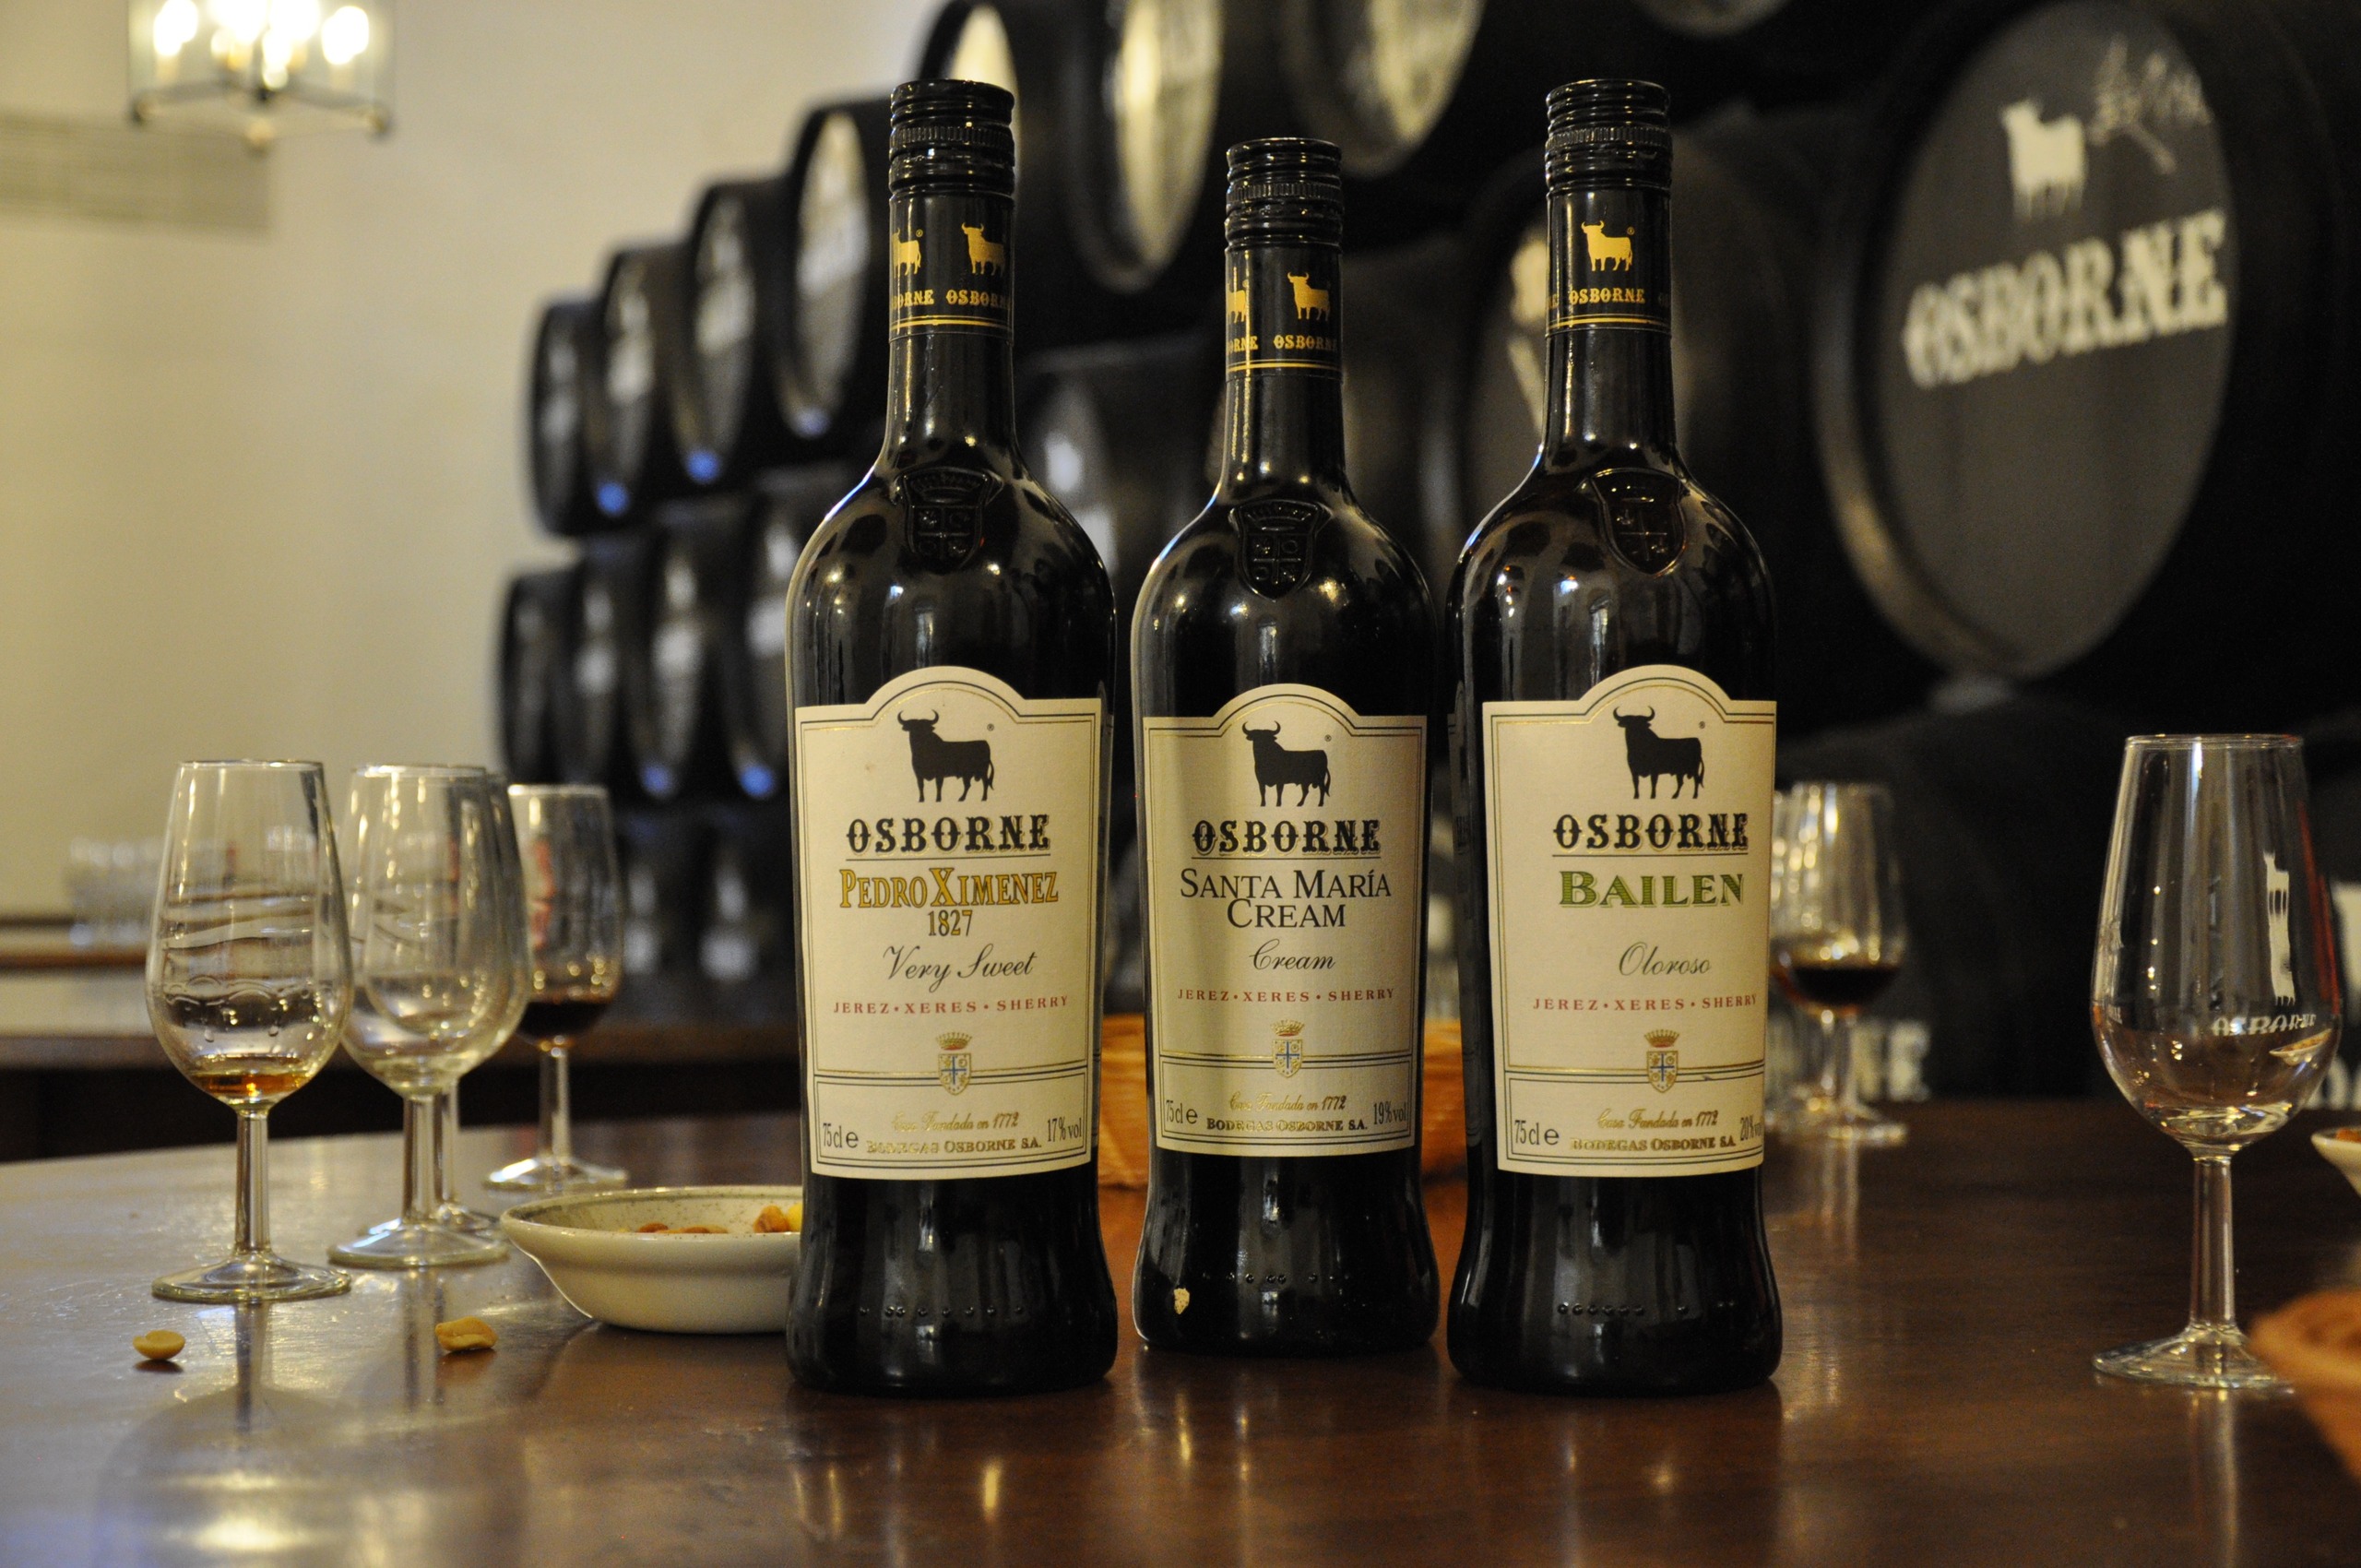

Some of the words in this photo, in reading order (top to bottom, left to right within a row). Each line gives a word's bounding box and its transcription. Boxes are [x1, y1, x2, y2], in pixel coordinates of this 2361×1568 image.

[1569, 288, 1646, 305] OSBORNE
[1903, 208, 2227, 388] OSBORNE
[846, 814, 1050, 855] OSBORNE
[1192, 819, 1381, 856] OSBORNE
[1553, 813, 1749, 853] OSBORNE
[1180, 868, 1283, 899] SANTA
[1293, 869, 1392, 899] MARÍA
[1559, 871, 1744, 909] BAILEN
[927, 909, 973, 936] 1827
[1227, 897, 1347, 929] CREAM
[883, 945, 953, 993] Very
[956, 944, 1038, 979] Sweet
[1249, 938, 1336, 970] Cream
[1619, 942, 1712, 977] Oloroso
[834, 1002, 889, 1015] JEREZ
[905, 1001, 977, 1015] XERES
[997, 995, 1068, 1012] SHERRY
[1177, 989, 1230, 1002] JEREZ
[1242, 992, 1310, 1003] XERES
[1327, 988, 1394, 1002] SHERRY
[1533, 998, 1598, 1011] JEREZ
[1614, 998, 1685, 1011] XERES
[1702, 993, 1757, 1010] SHERRY
[1321, 1095, 1347, 1111] 1772
[992, 1111, 1019, 1130] 1772
[1206, 1118, 1274, 1132] BODEGAS
[1276, 1120, 1344, 1132] OSBORNE
[943, 1139, 1015, 1153] OSBORNE
[1571, 1137, 1648, 1151] BODEGAS
[1651, 1137, 1715, 1151] OSBORNE
